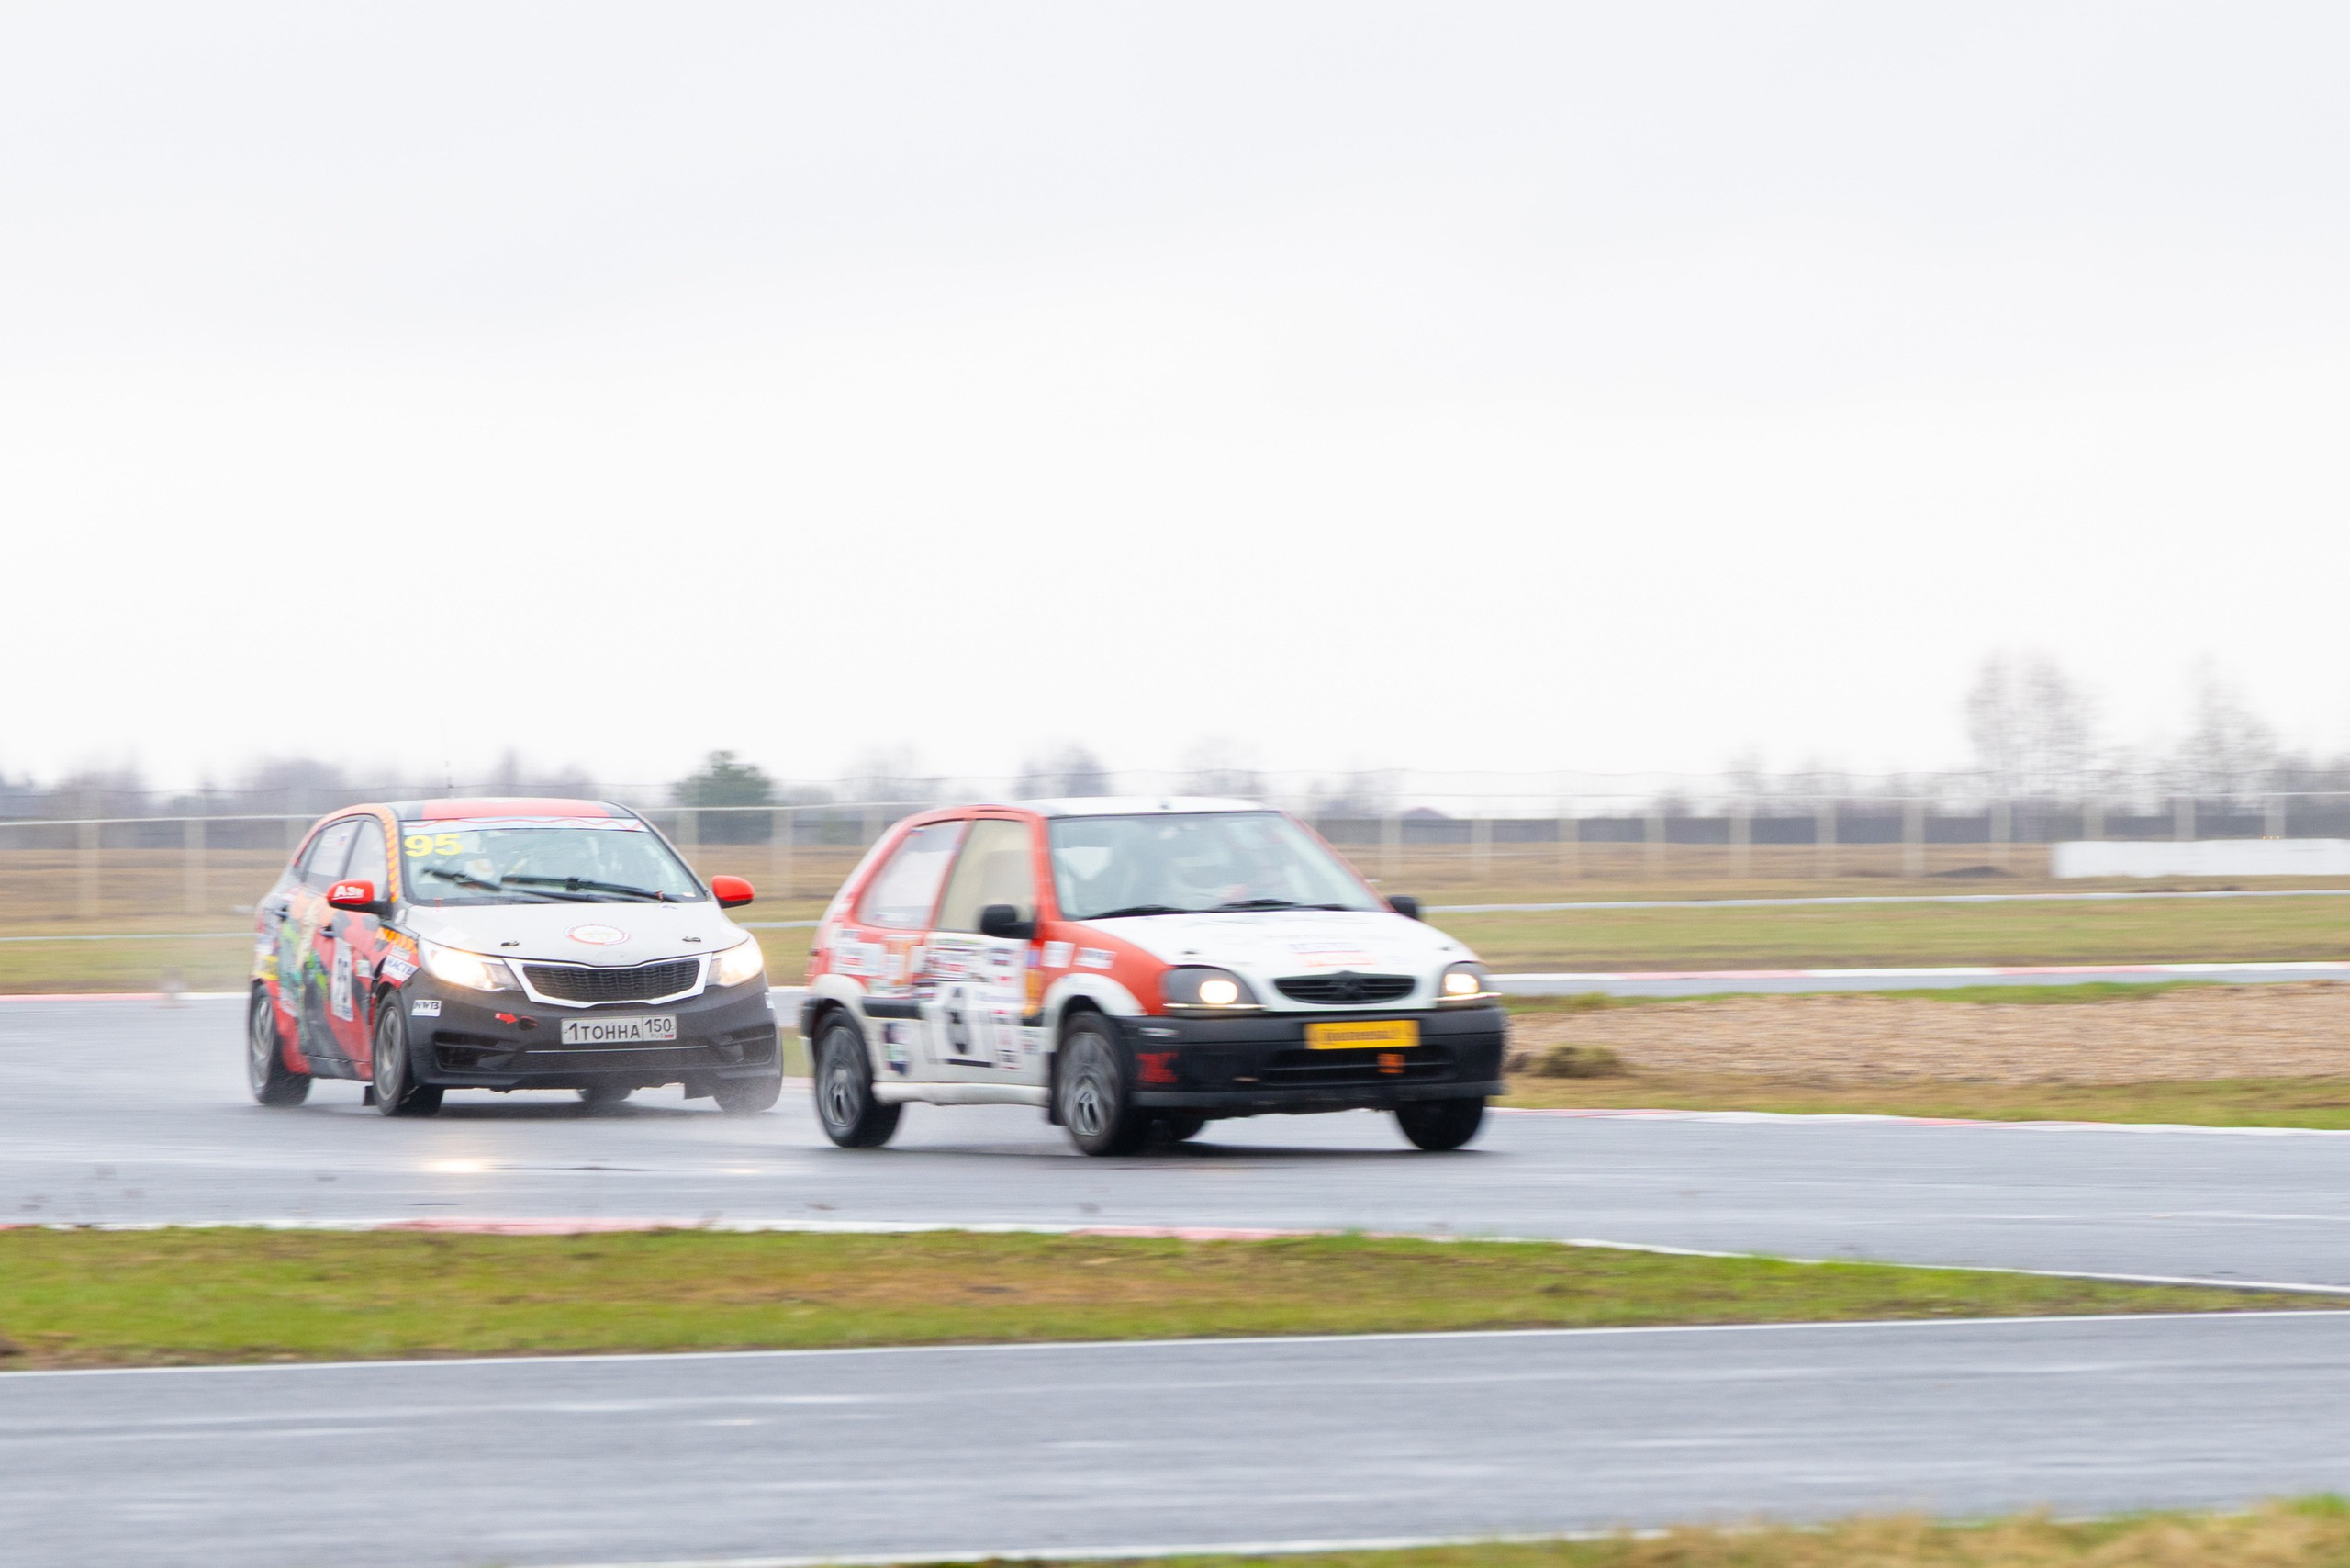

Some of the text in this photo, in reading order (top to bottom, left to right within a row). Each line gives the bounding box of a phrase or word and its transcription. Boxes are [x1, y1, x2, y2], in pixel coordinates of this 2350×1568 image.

[405, 834, 464, 857] 95
[568, 1018, 672, 1041] 1ТОННА 150
